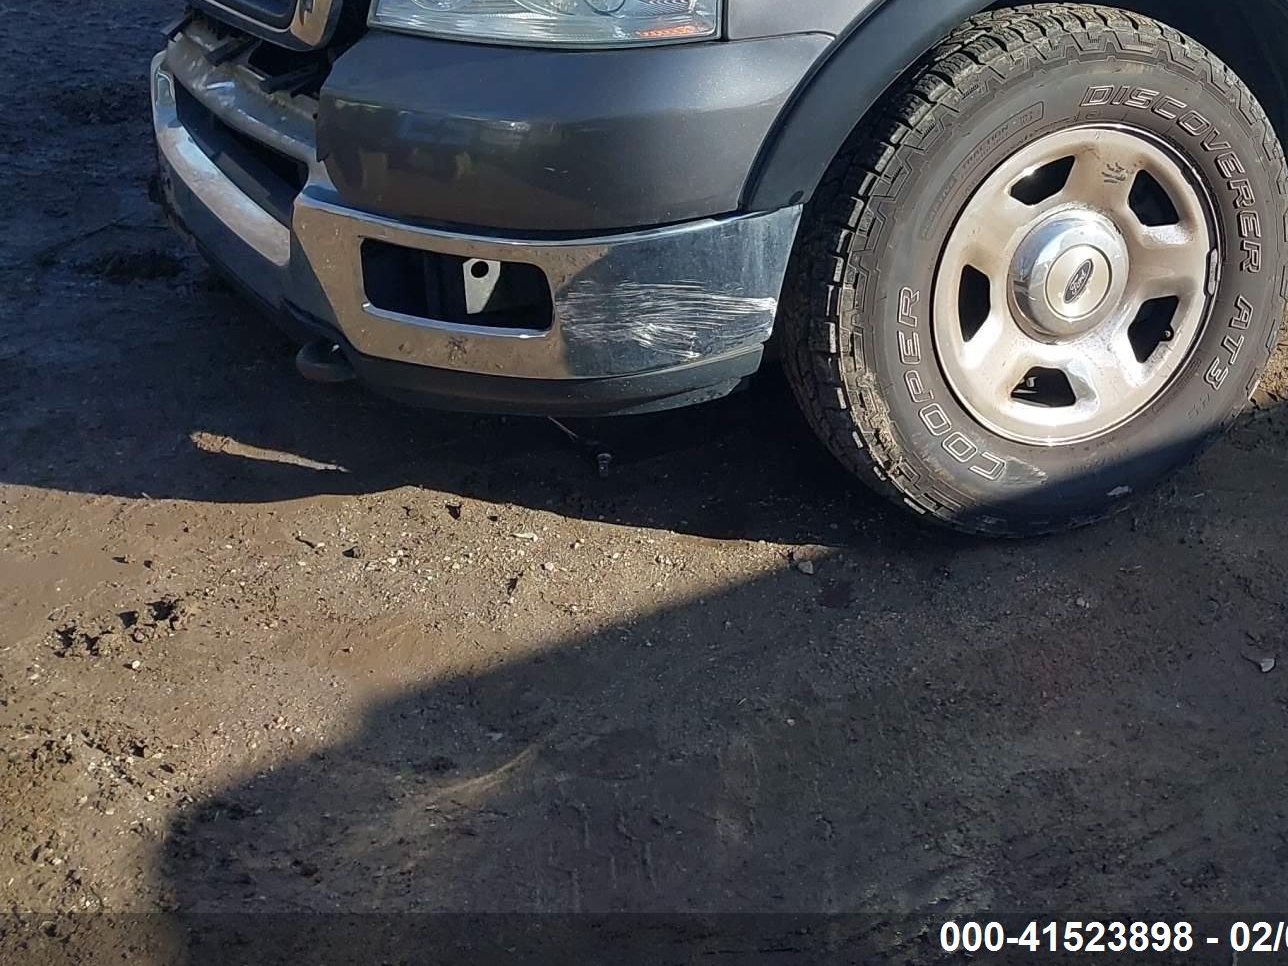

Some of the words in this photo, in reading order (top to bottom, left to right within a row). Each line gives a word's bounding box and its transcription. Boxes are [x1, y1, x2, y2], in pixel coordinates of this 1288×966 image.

[1079, 84, 1263, 275] DISCOVERER
[1203, 294, 1254, 391] AT3
[897, 286, 1006, 481] COOPER
